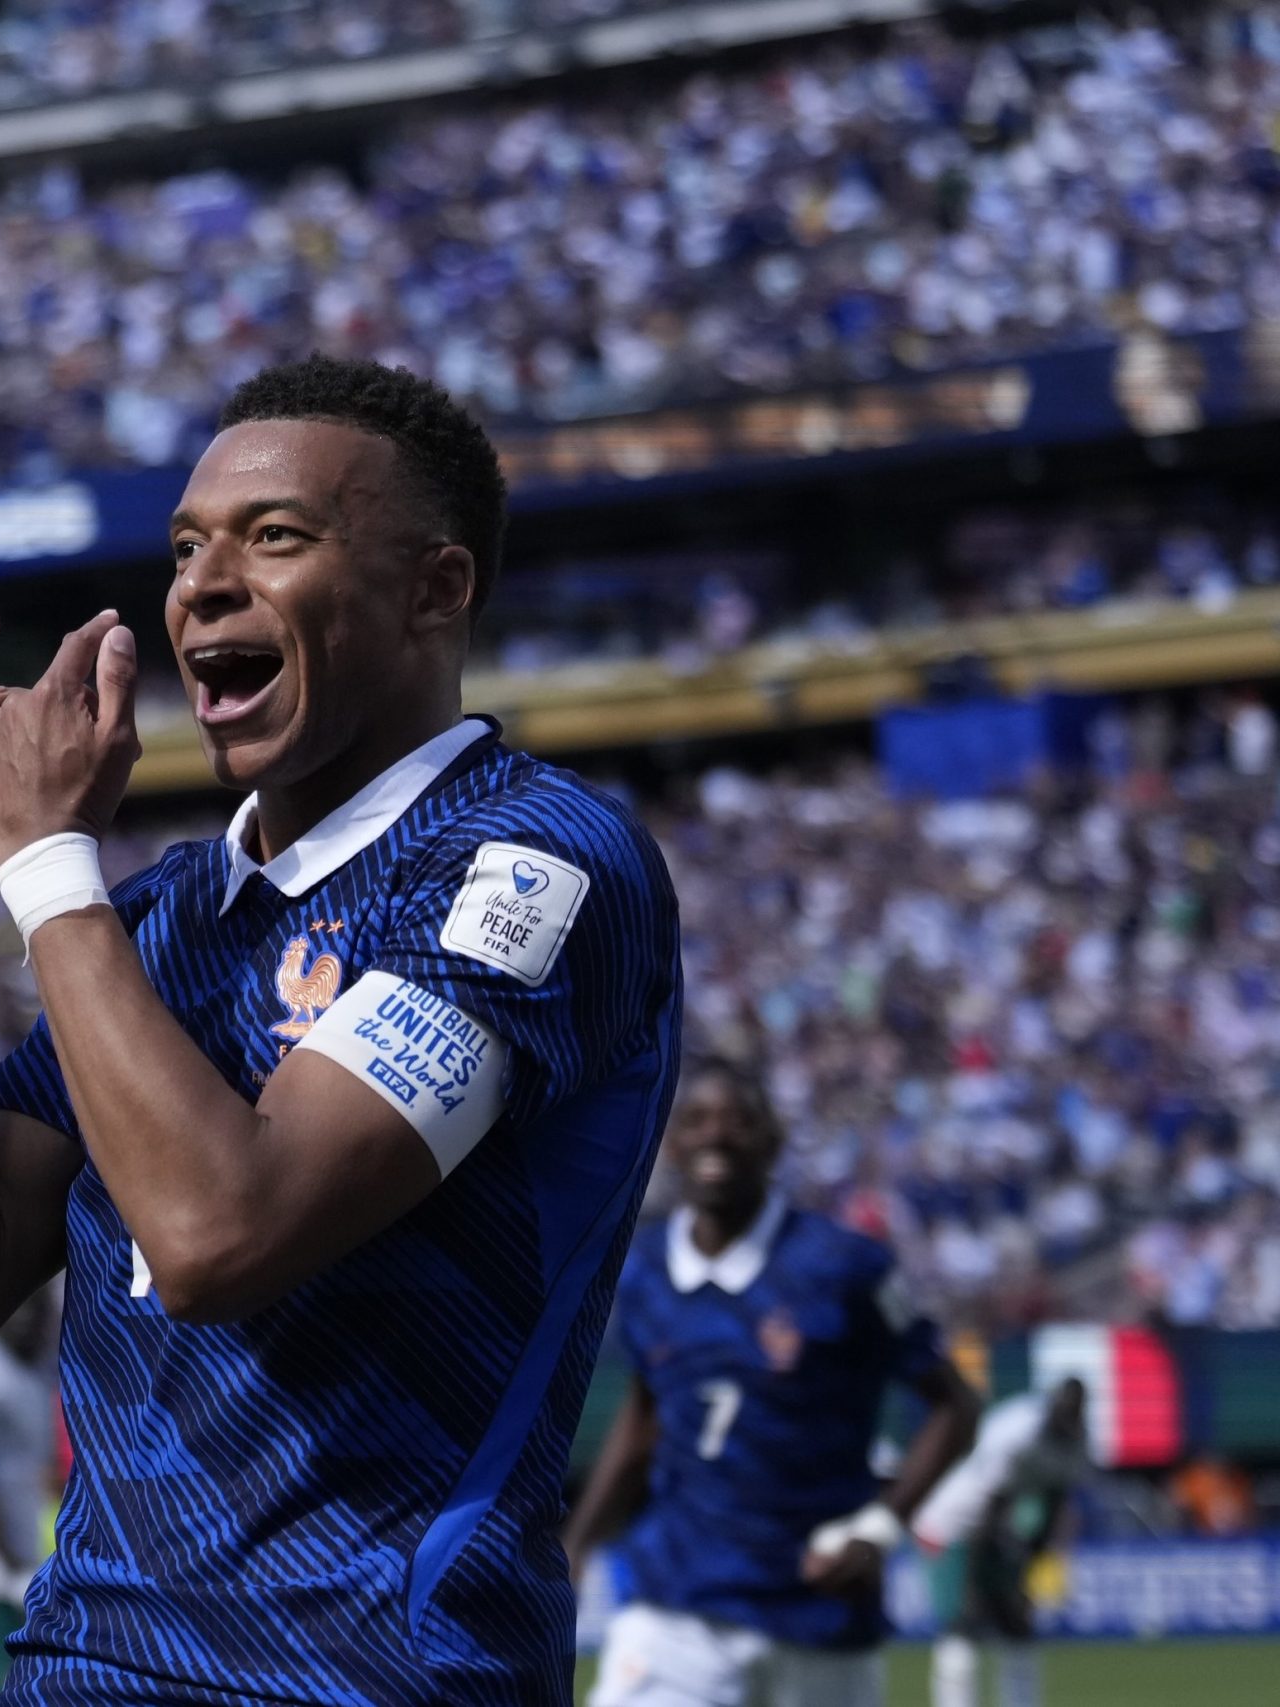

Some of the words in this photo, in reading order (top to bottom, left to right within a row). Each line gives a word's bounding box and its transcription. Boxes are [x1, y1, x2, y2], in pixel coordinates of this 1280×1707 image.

[480, 910, 533, 949] PEACE
[484, 889, 523, 916] Unite
[522, 905, 543, 926] For
[483, 936, 511, 956] FIFA
[376, 993, 477, 1087] UNITES
[396, 980, 489, 1063] FOOTBALL
[354, 1017, 393, 1050] the
[393, 1043, 465, 1116] World
[372, 1063, 411, 1101] FIFA
[697, 1381, 742, 1461] 7
